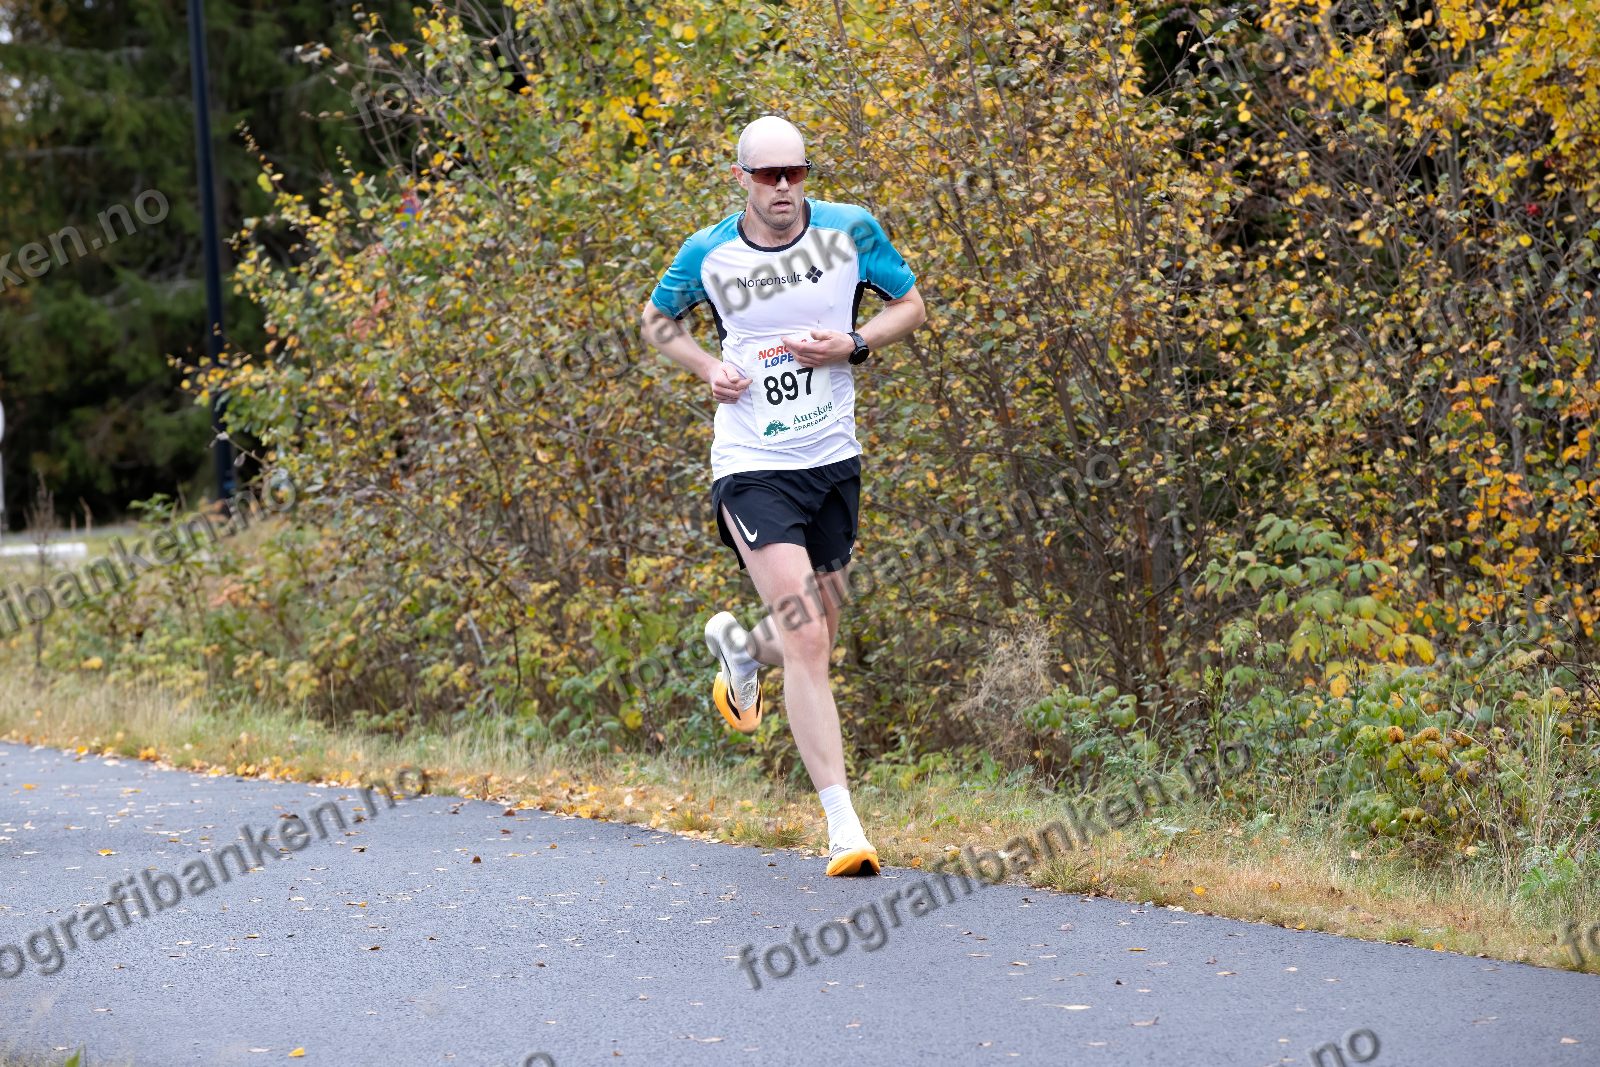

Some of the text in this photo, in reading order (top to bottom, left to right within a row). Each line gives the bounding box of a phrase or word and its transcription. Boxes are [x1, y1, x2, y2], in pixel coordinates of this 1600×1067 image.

[737, 272, 803, 289] Norconsult
[765, 353, 795, 369] LØPE
[763, 367, 814, 405] 897
[793, 401, 832, 425] Aurskog
